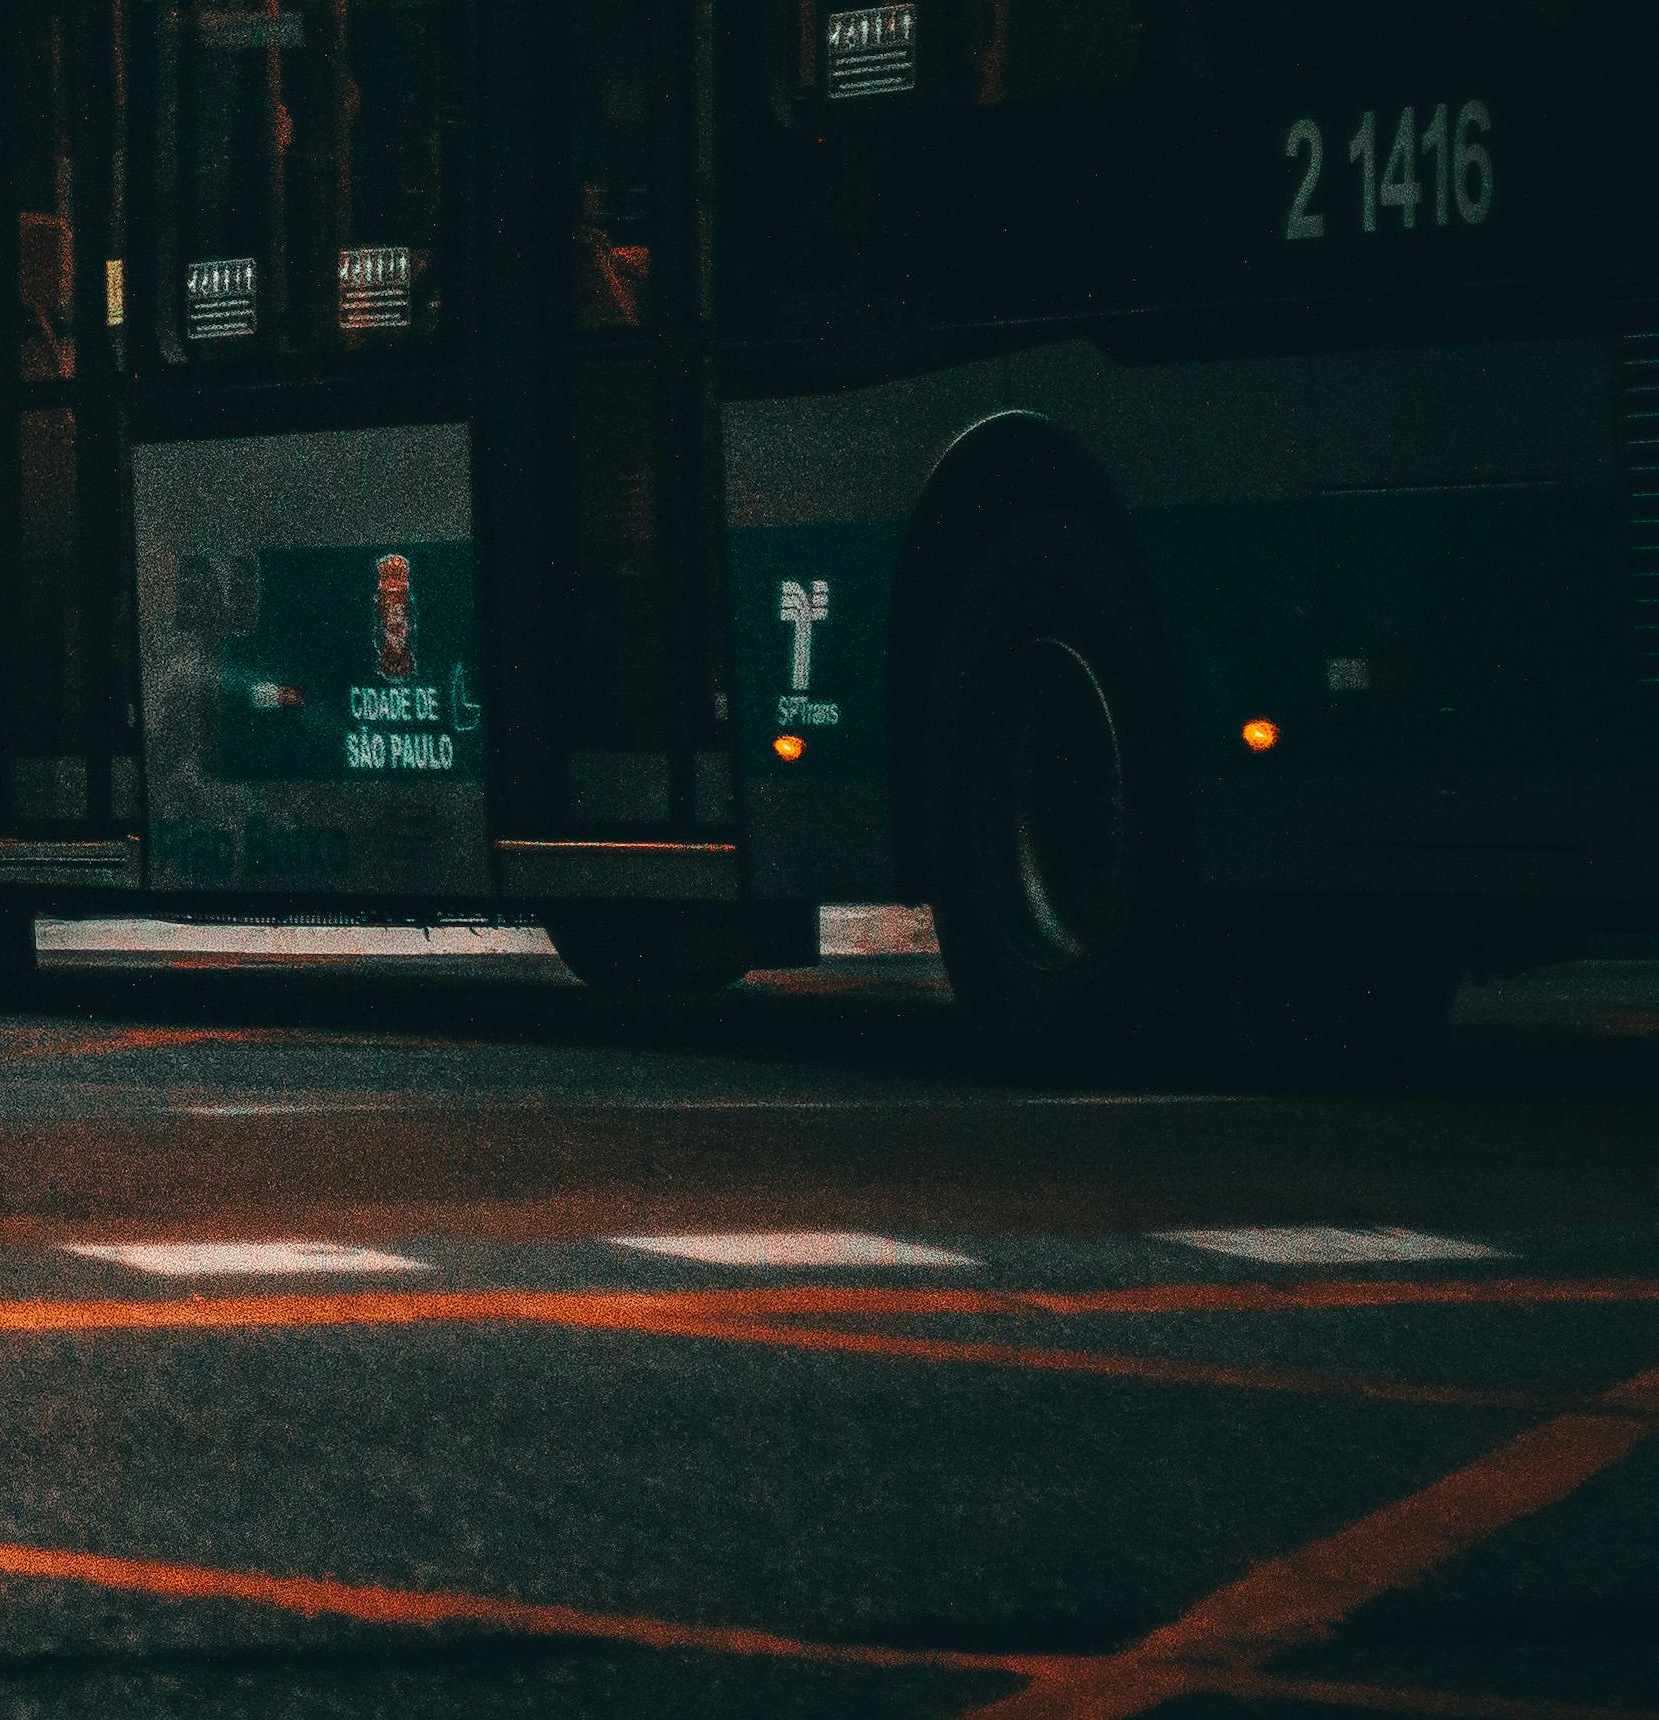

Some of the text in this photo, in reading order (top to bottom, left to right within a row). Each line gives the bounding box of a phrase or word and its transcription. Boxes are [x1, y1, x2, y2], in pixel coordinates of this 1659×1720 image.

[1285, 97, 1492, 240] 2 1416
[349, 685, 439, 721] CIDADE DE
[347, 724, 454, 770] SÃO PAULO
